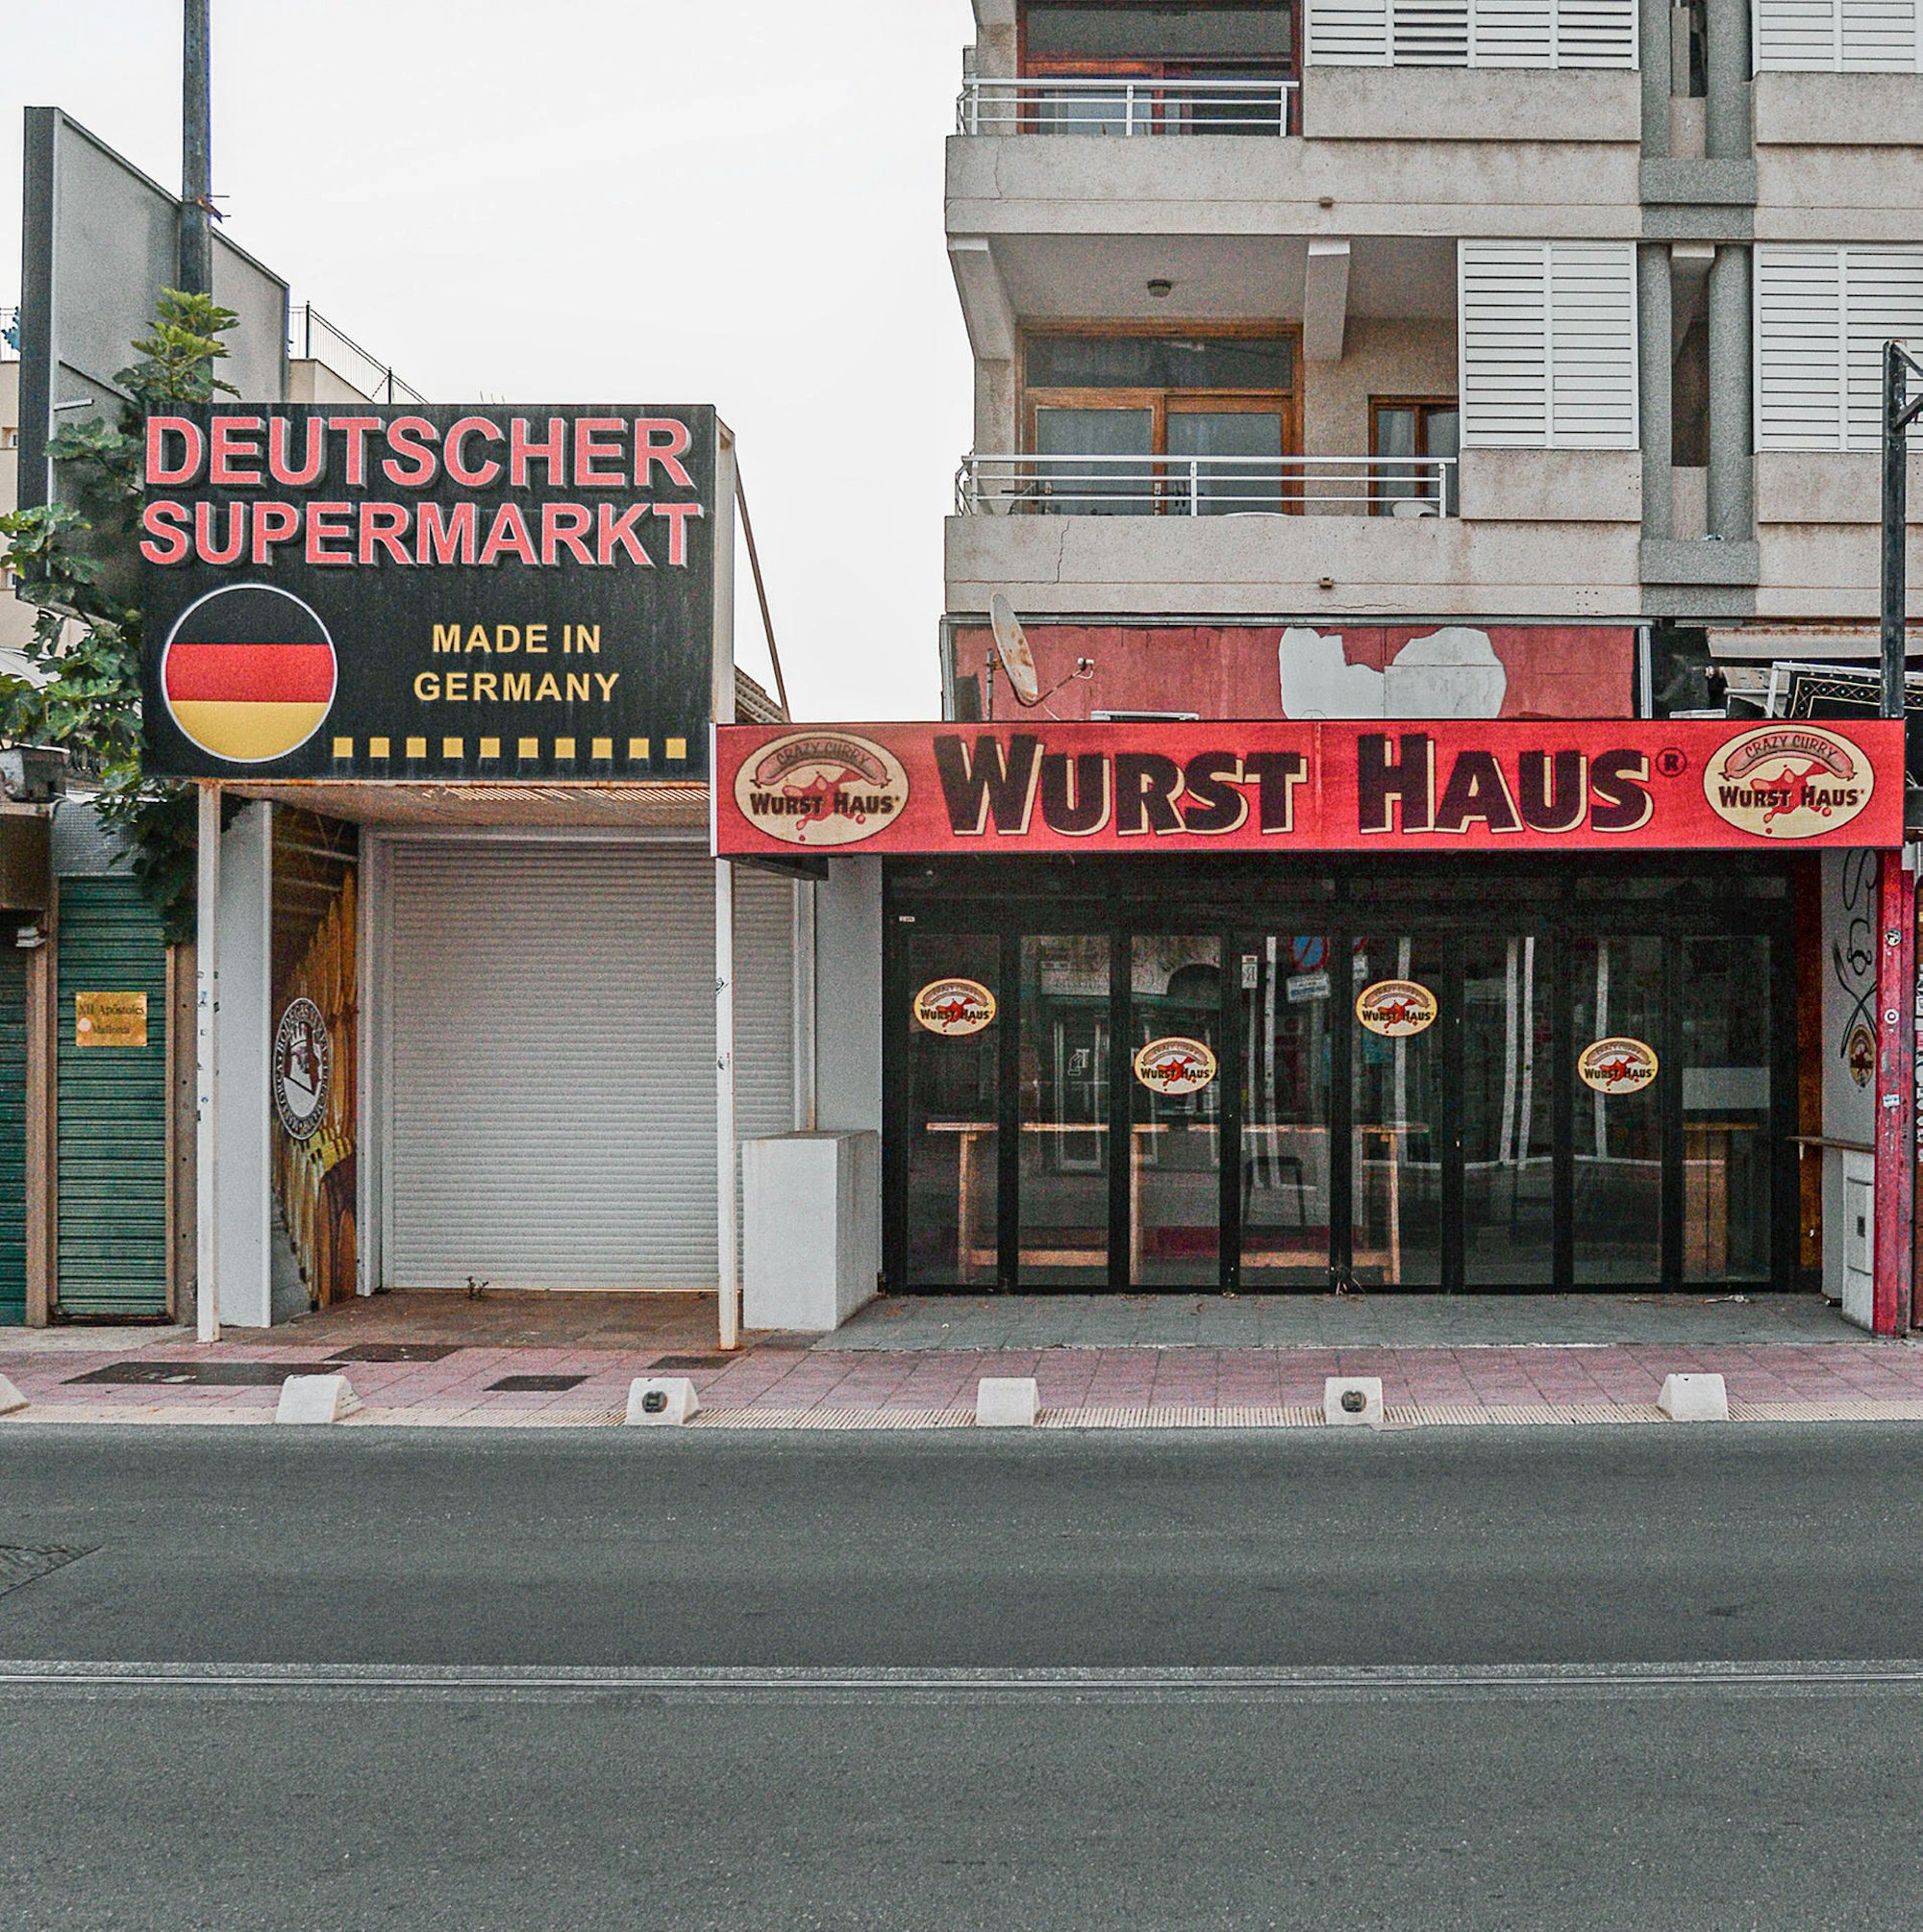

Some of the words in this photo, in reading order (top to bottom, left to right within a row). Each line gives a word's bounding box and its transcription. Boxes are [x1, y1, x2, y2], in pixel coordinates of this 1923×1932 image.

[146, 416, 696, 489] DEUTSCHER
[139, 500, 704, 567] SUPERMARKT
[433, 624, 548, 653] MADE
[562, 624, 601, 653] IN
[413, 672, 619, 701] GERMANY
[776, 740, 821, 765] CRAZY
[824, 741, 871, 765] CURRY
[1745, 735, 1790, 759] CRAZY
[1792, 735, 1837, 760] CURRY
[933, 734, 1309, 837] WURST
[1718, 786, 1793, 809] WURST
[750, 792, 825, 815] WURST
[920, 1009, 956, 1019] WURST
[1362, 1011, 1397, 1021] WURST
[1140, 1067, 1175, 1079] WURST
[1585, 1067, 1618, 1079] WURST
